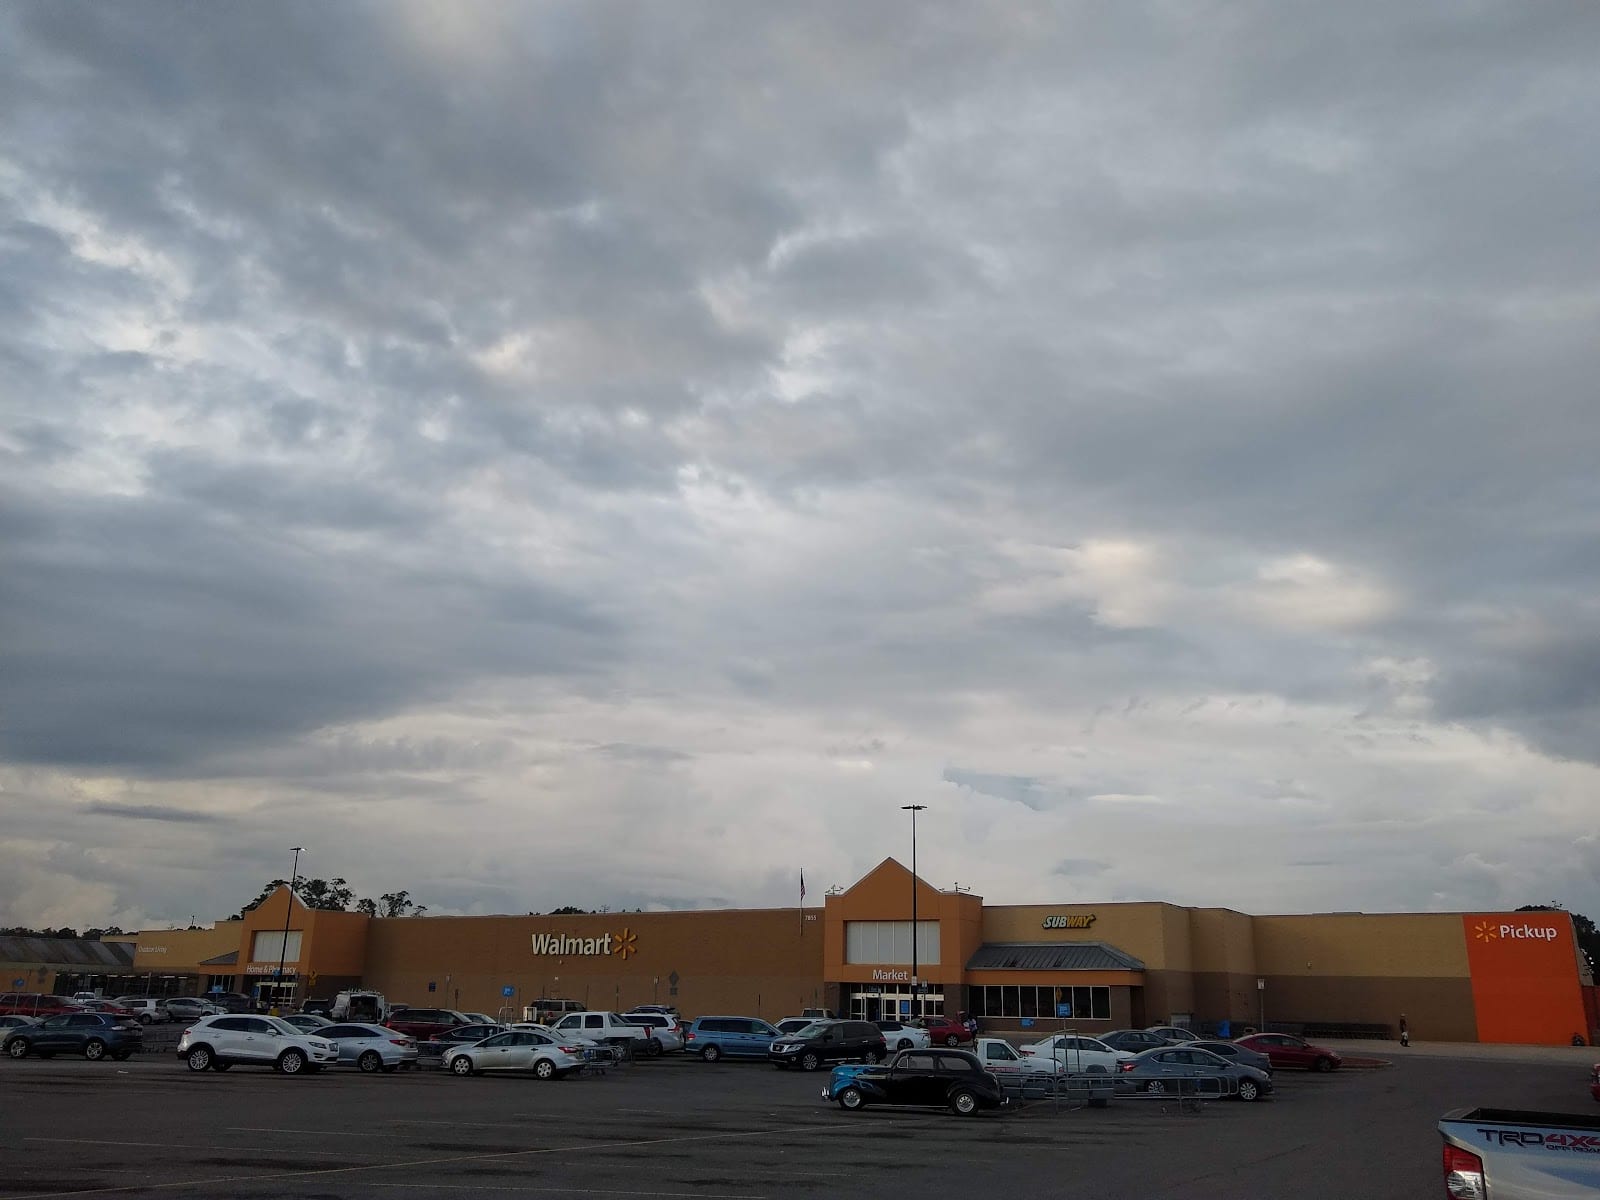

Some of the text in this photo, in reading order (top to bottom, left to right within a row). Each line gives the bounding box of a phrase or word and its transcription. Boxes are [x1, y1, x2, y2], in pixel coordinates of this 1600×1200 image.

[1042, 914, 1096, 929] SUBWAY
[1499, 924, 1558, 941] Pickup
[531, 933, 612, 955] Walmart
[246, 964, 262, 974] Home
[872, 969, 908, 980] Market
[1477, 1128, 1545, 1148] TRD
[1571, 1146, 1600, 1154] ROA
